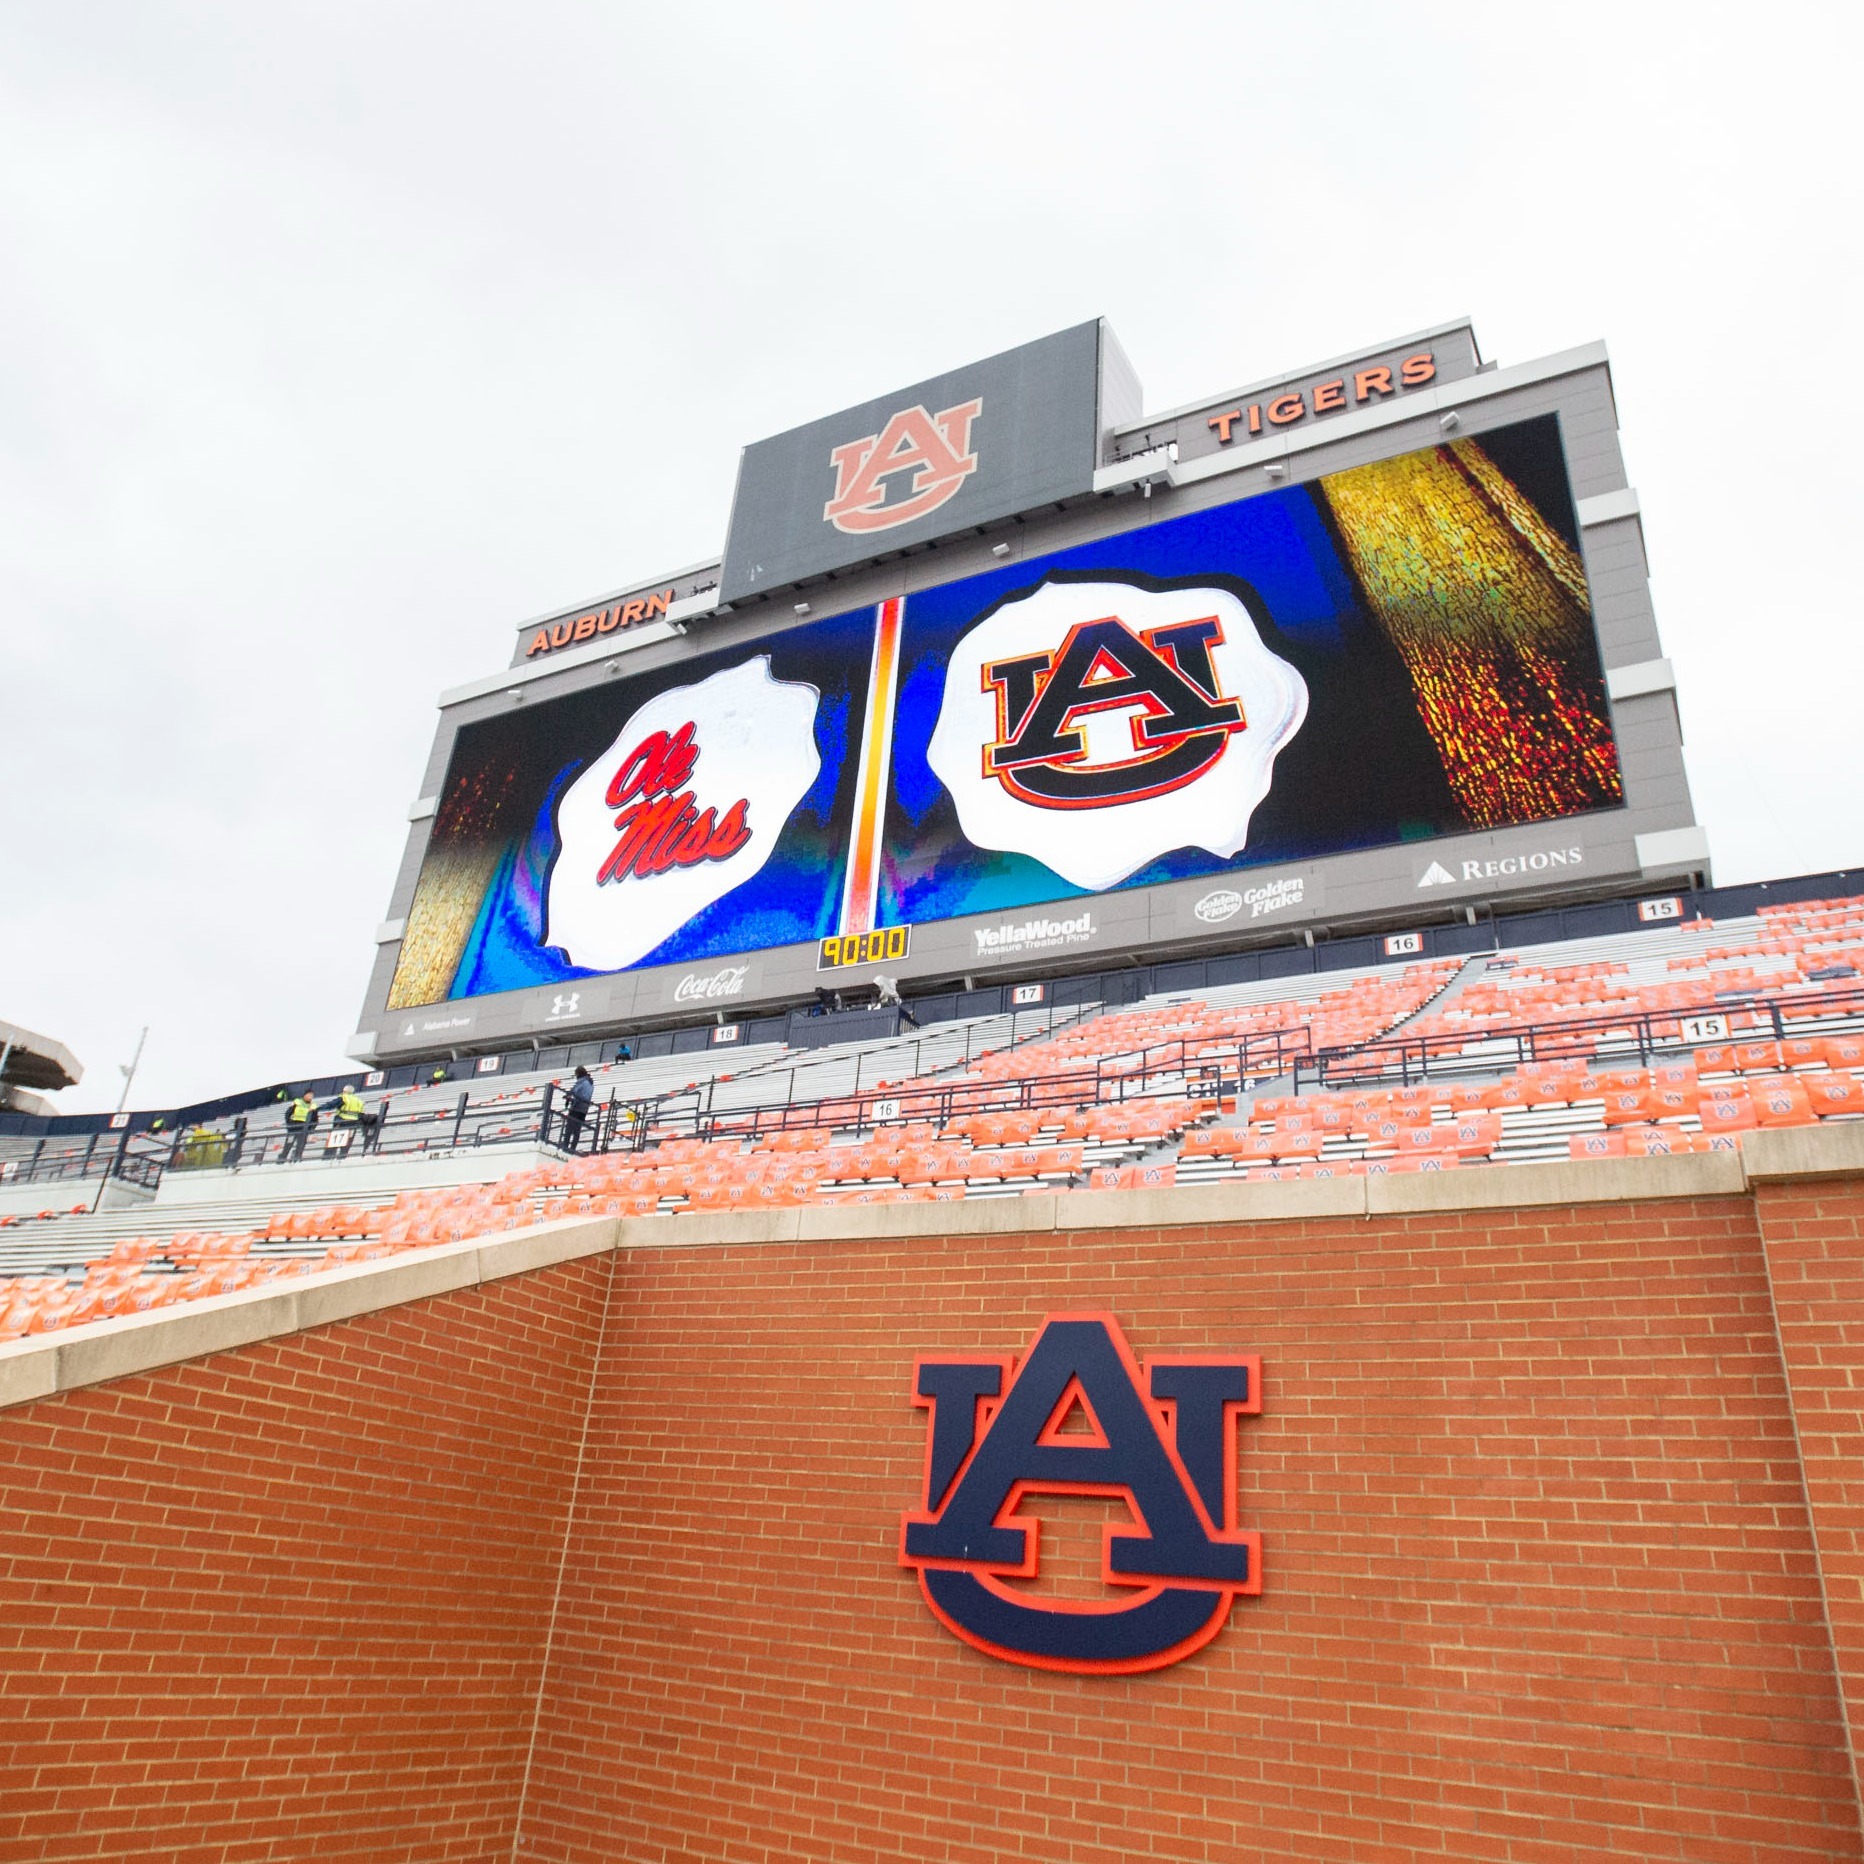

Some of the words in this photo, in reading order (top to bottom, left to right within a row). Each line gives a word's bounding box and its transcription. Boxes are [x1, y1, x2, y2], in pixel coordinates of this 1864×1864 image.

[1207, 353, 1437, 444] TIGERS
[526, 588, 674, 657] AUBURN
[605, 720, 700, 809] Ole
[597, 790, 753, 887] Miss
[1461, 847, 1583, 881] REGIONS
[1243, 878, 1305, 904] Golden
[1250, 890, 1304, 918] Flake
[1648, 902, 1672, 916] 15
[824, 926, 906, 966] 90:00
[977, 943, 1022, 956] Pressure
[1024, 935, 1064, 949] Treated
[1066, 932, 1090, 943] Pine
[1393, 937, 1414, 951] 16
[674, 964, 751, 1003] Coca-Cola
[1019, 987, 1037, 999] 17
[720, 1028, 733, 1040] 18
[1689, 1019, 1719, 1037] 15
[879, 1103, 893, 1116] 16
[333, 1132, 346, 1144] 17
